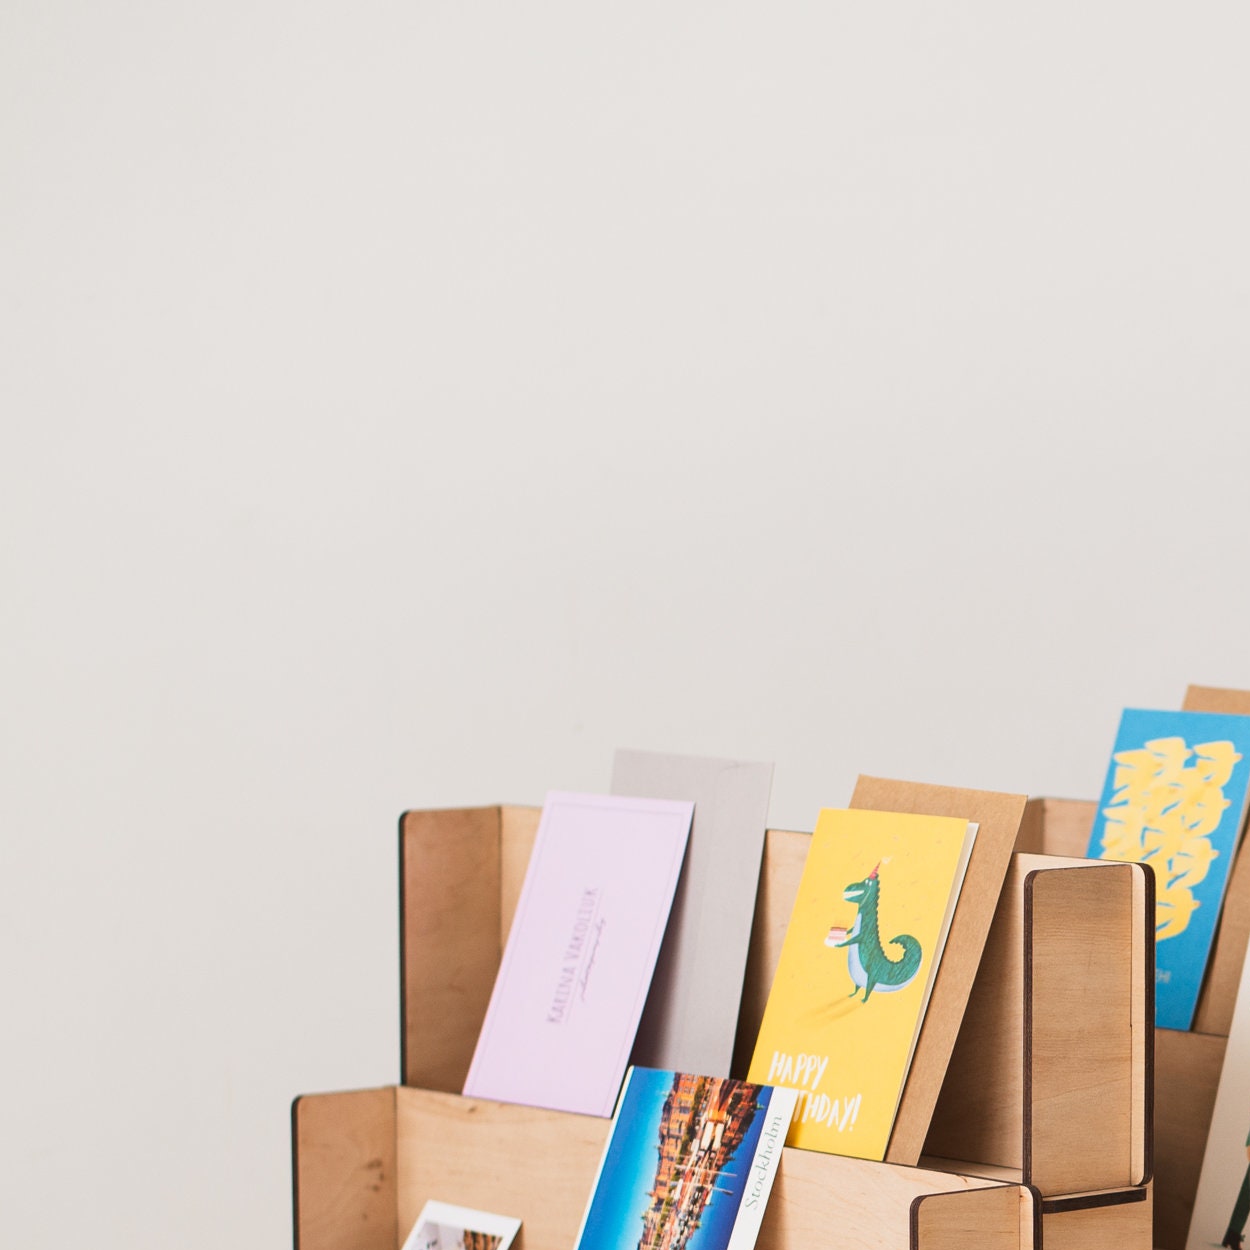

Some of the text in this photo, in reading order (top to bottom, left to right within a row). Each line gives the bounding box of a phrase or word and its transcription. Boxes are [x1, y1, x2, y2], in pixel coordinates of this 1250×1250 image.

[768, 1051, 829, 1091] HAPPY
[794, 1089, 862, 1133] THDAY!
[744, 1115, 783, 1211] Stockholm
